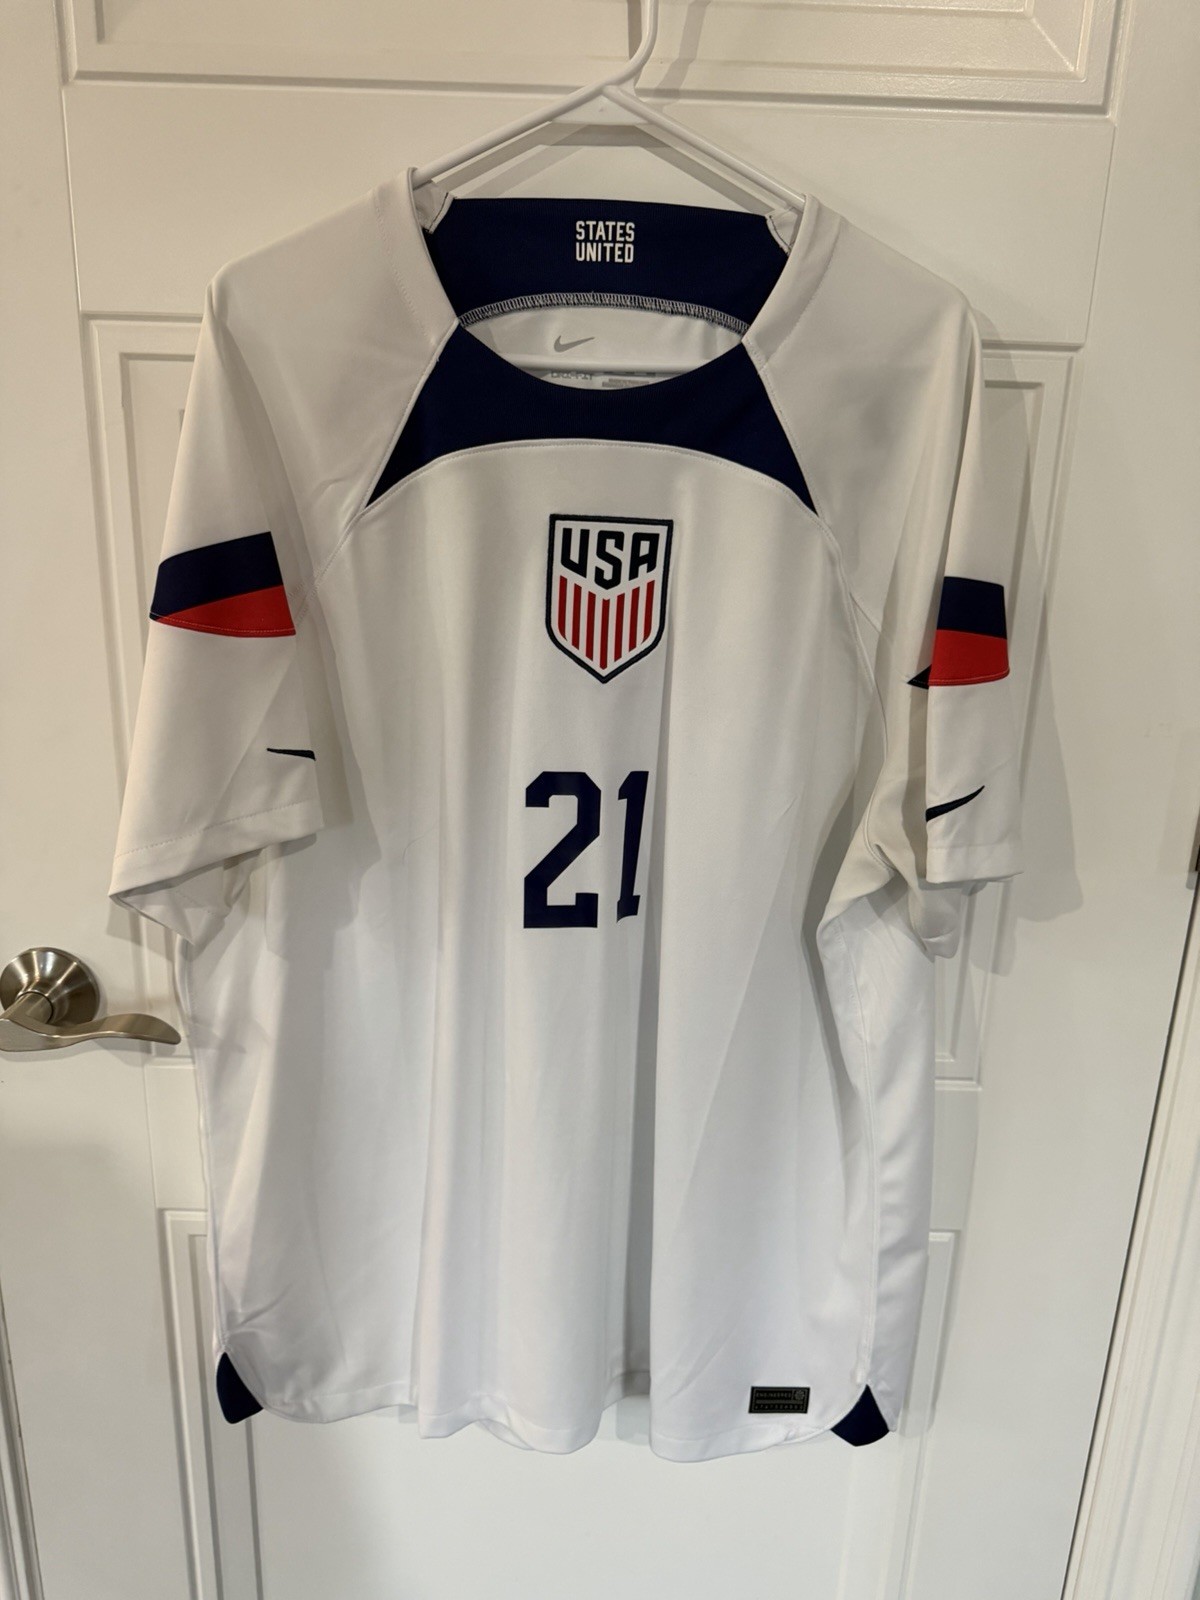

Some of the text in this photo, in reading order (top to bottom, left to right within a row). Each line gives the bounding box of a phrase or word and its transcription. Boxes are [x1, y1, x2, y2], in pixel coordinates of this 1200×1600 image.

[575, 220, 636, 242] STATES
[575, 242, 634, 263] UNITED
[560, 527, 660, 590] USA
[523, 770, 649, 929] 21
